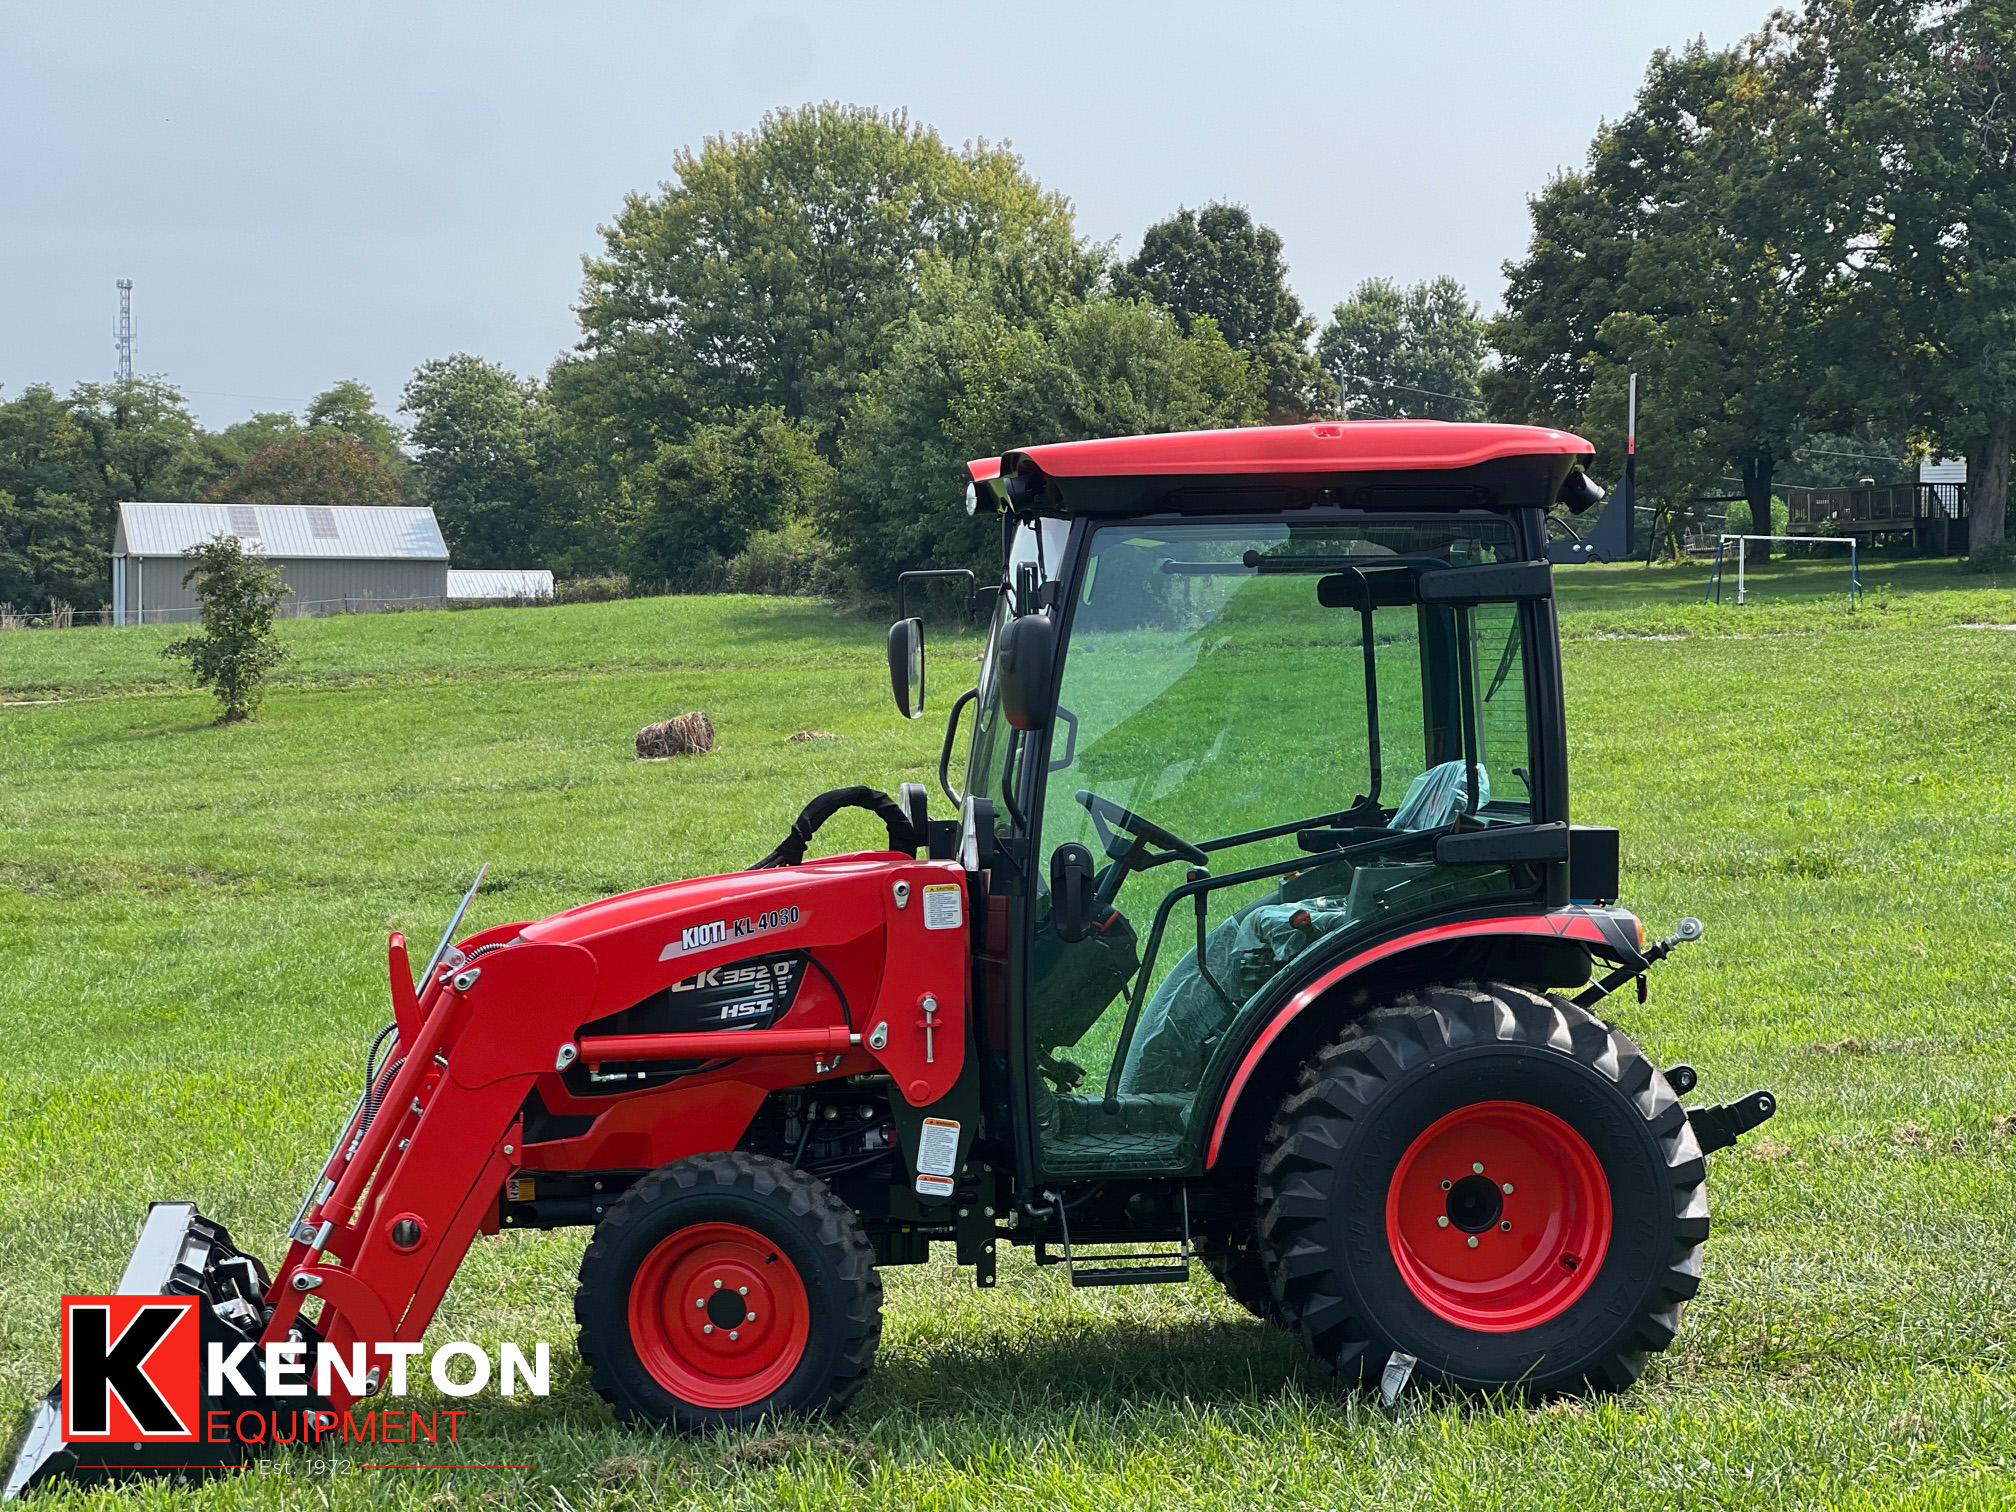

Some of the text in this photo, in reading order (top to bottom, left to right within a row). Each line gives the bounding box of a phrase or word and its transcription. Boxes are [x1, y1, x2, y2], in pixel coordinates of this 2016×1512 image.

[682, 905, 800, 951] KIOTI KL 4030
